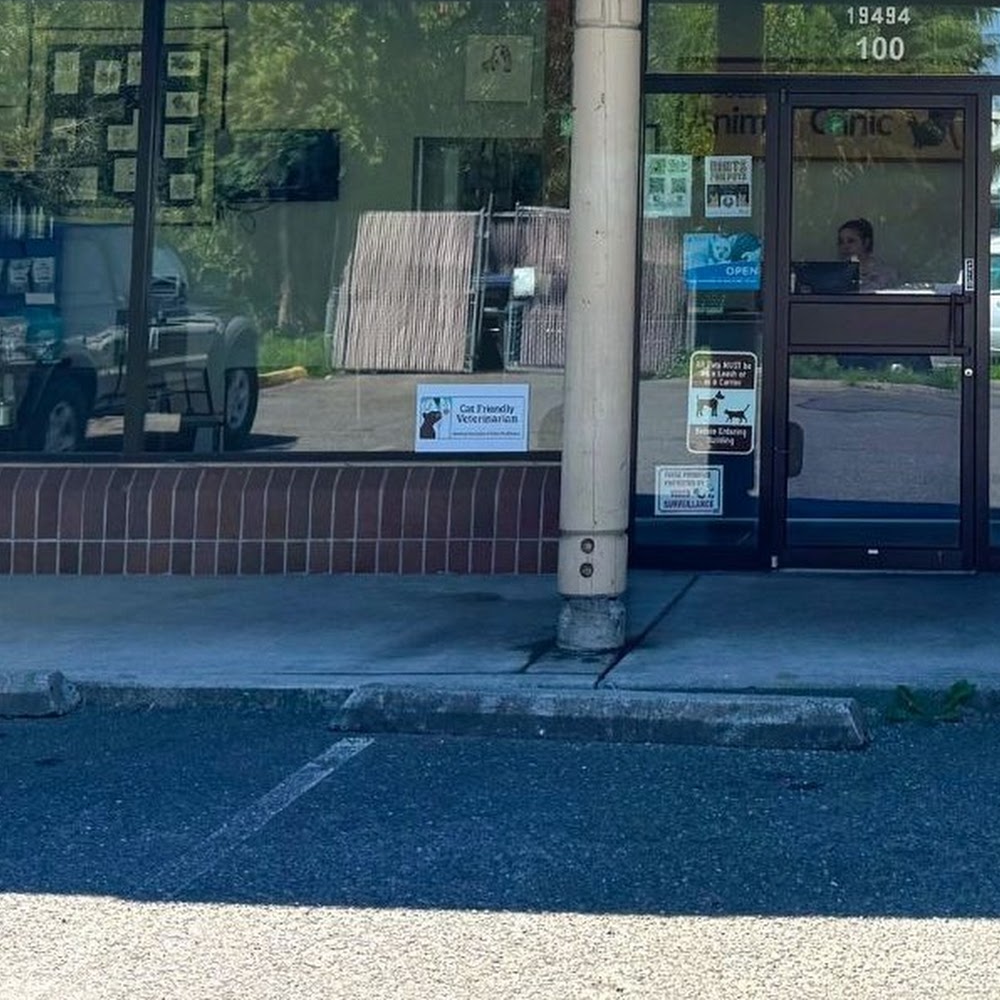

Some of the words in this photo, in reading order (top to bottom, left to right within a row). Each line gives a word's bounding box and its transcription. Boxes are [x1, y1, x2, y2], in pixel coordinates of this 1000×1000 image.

[847, 6, 911, 25] 19494
[856, 36, 904, 60] 100
[726, 266, 758, 277] OPEN
[459, 404, 475, 414] Cat
[477, 404, 515, 415] Friendly
[456, 414, 519, 424] Veterinarian
